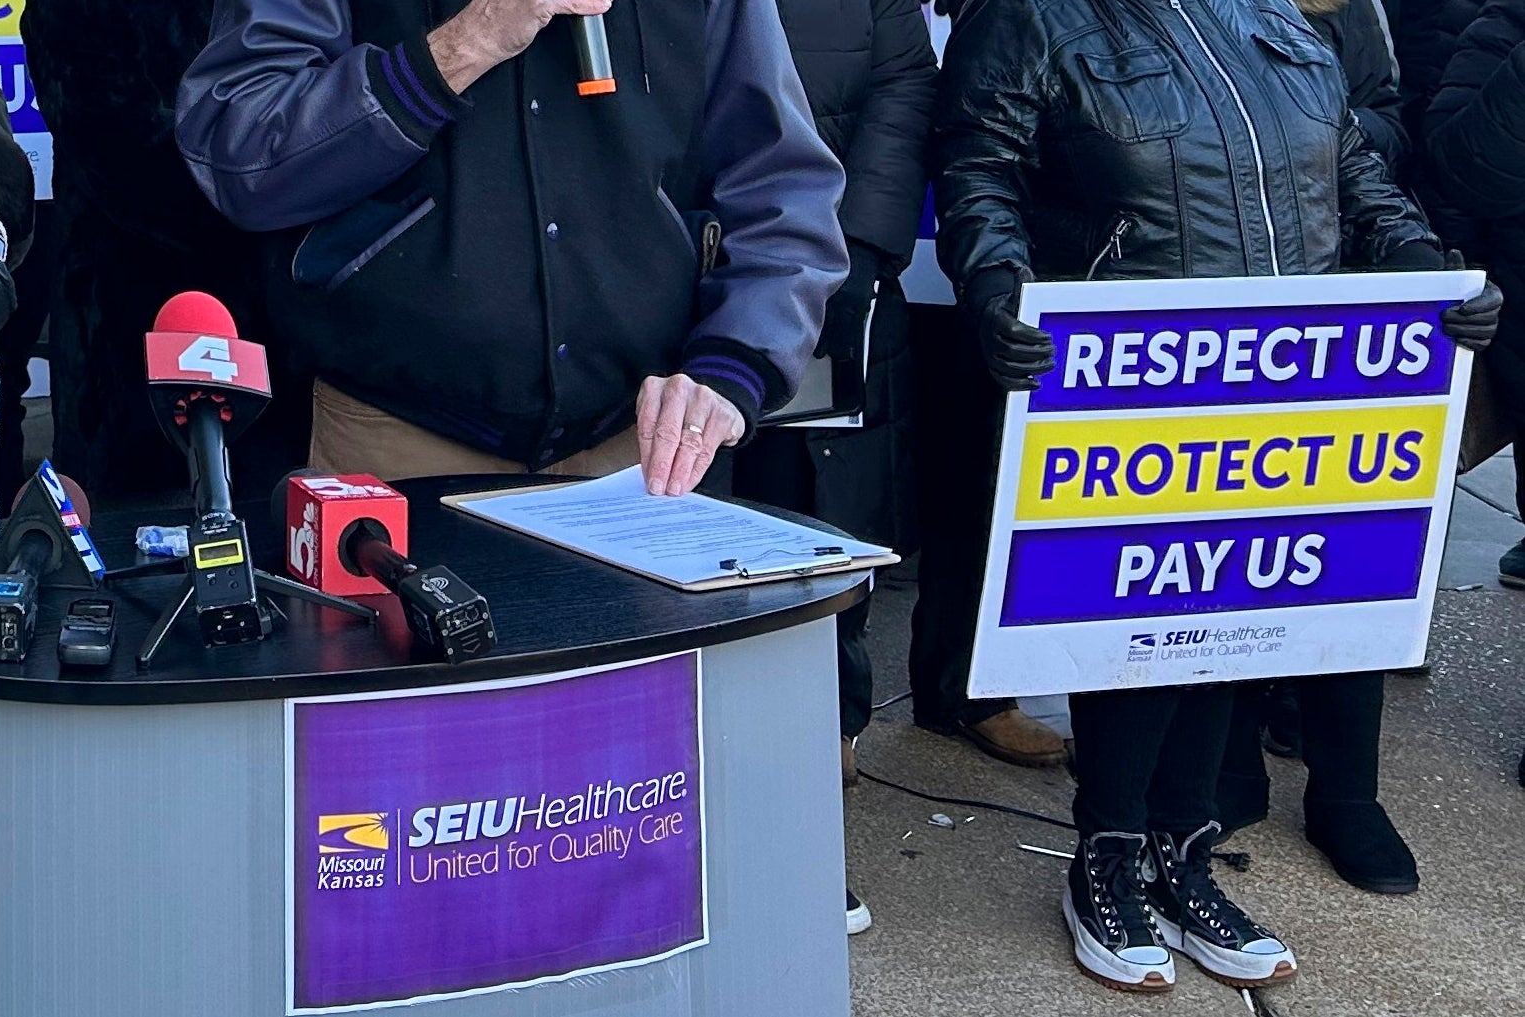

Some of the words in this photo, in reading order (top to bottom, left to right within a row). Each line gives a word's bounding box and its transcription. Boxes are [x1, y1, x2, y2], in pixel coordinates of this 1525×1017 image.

[178, 336, 238, 383] 4
[1063, 325, 1344, 388] RESPECT
[1355, 322, 1433, 378] US
[1040, 434, 1335, 500] PROTECT
[1348, 431, 1424, 484] US
[1115, 539, 1235, 597] PAY
[1246, 534, 1325, 589] US
[1161, 648, 1197, 661] United
[1257, 640, 1282, 652] Care
[317, 853, 385, 874] Missouri
[409, 844, 499, 883] United
[507, 841, 543, 870] for
[549, 824, 634, 862] Quality
[638, 811, 683, 844] Care
[317, 873, 384, 890] Kansas
